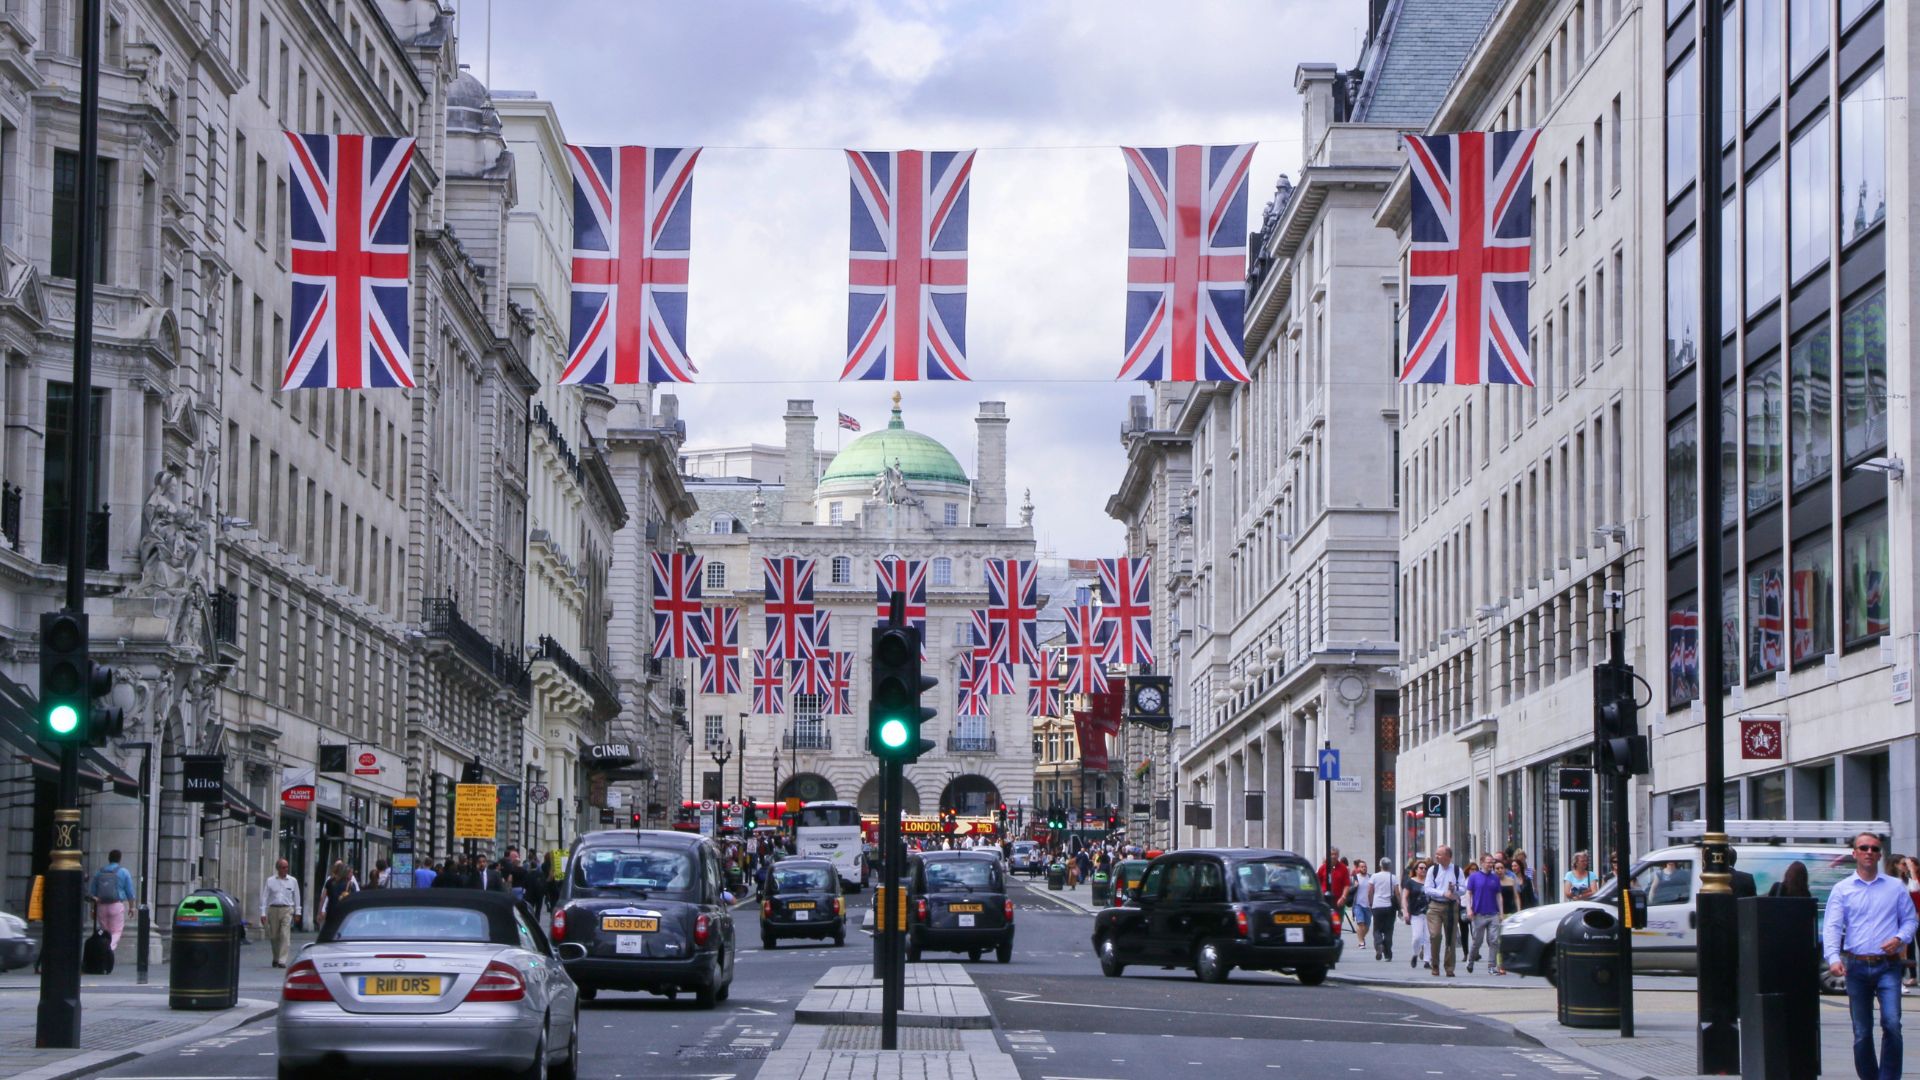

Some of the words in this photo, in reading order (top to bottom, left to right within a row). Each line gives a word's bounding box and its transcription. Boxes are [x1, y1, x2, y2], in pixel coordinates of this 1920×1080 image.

[550, 729, 560, 738] 15
[592, 744, 630, 758] CINEMA
[187, 778, 221, 789] Milos
[607, 918, 632, 929] LO63
[634, 919, 652, 929] OCK
[401, 977, 430, 993] ORS
